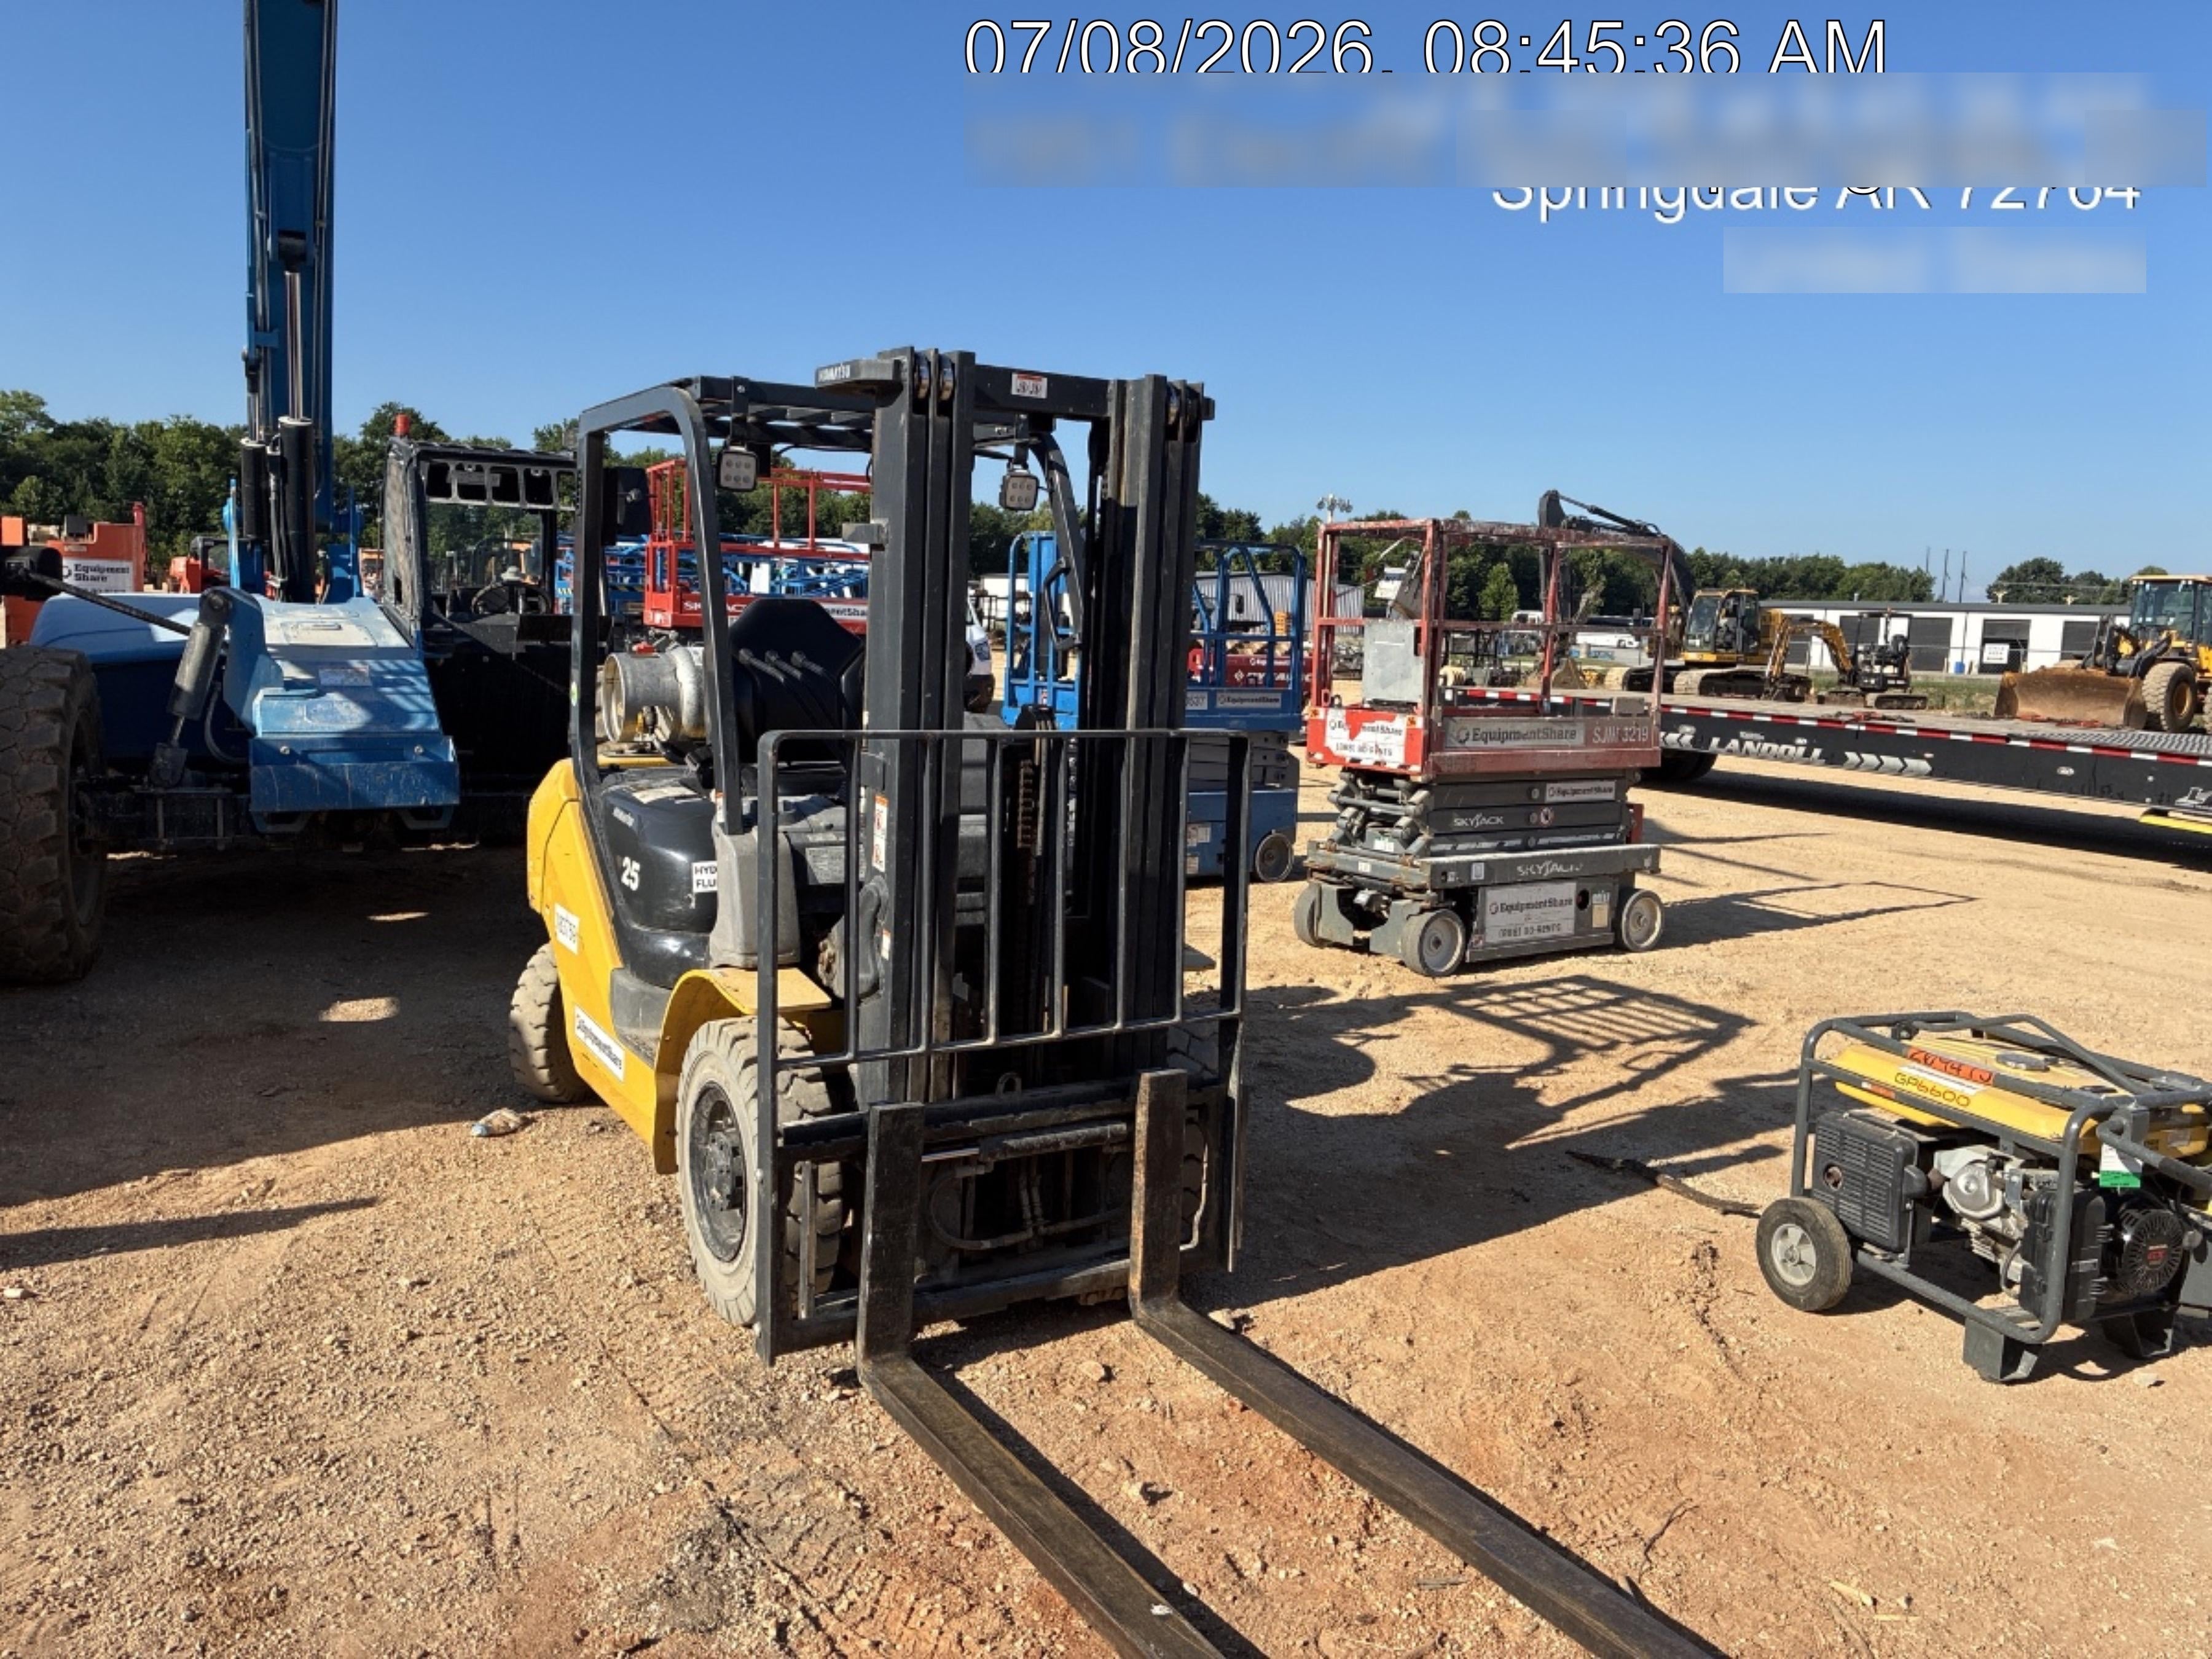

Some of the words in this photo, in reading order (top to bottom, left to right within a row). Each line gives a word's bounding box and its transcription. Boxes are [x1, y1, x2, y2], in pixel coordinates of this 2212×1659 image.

[74, 563, 130, 575] Equipment
[74, 573, 108, 582] Share
[1472, 727, 1577, 744] EquipmentShare
[1622, 725, 1649, 742] 3219
[1709, 736, 1826, 764] LANDOLL
[1453, 812, 1505, 828] SKYJACK
[621, 856, 640, 891] 25
[694, 865, 717, 875] HYD
[696, 879, 717, 887] FLU
[1499, 896, 1574, 914] EquipmentShare
[1894, 1072, 1971, 1107] GP6600
